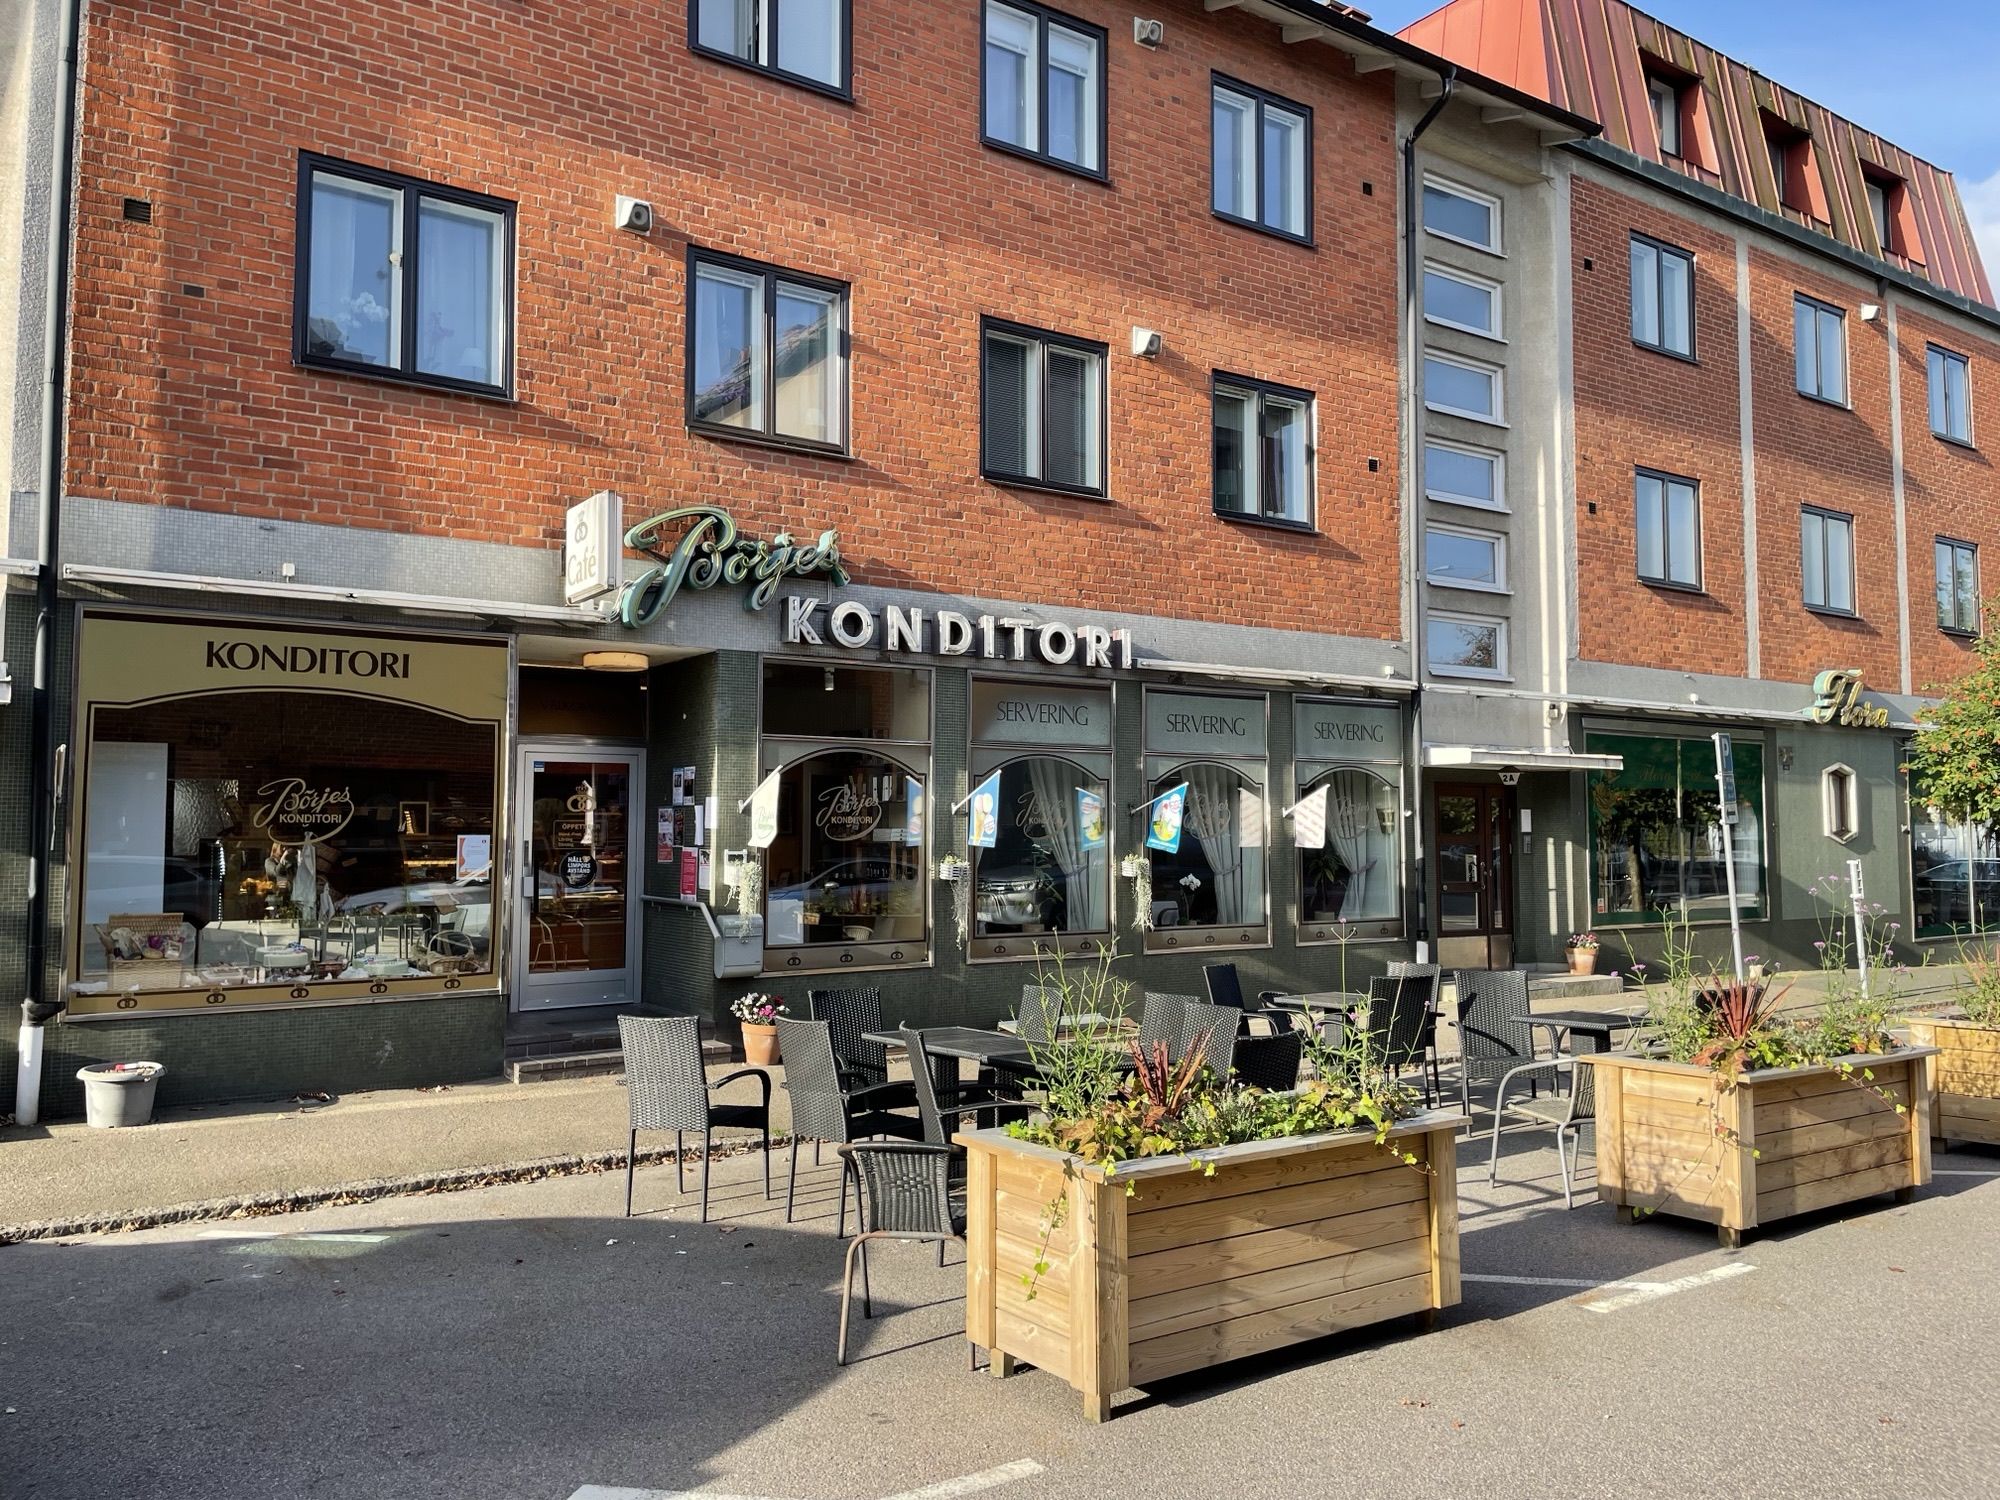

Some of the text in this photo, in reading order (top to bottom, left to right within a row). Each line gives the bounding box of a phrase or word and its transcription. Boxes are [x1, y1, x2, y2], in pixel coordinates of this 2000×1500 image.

[567, 545, 597, 587] Café
[622, 505, 851, 630] Börjes
[783, 595, 1133, 670] KONDITORI
[206, 640, 410, 678] KONDITORI
[1808, 668, 1889, 728] Flora
[996, 700, 1089, 726] SERVERING
[1166, 713, 1246, 736] SERVERING
[1313, 721, 1384, 743] SERVERING
[1720, 738, 1730, 769] P
[1502, 774, 1515, 783] 2A
[254, 778, 350, 828] Börjes
[279, 813, 342, 823] KONDITORI
[831, 815, 873, 825] KONDITORI
[567, 855, 582, 863] HÅLL
